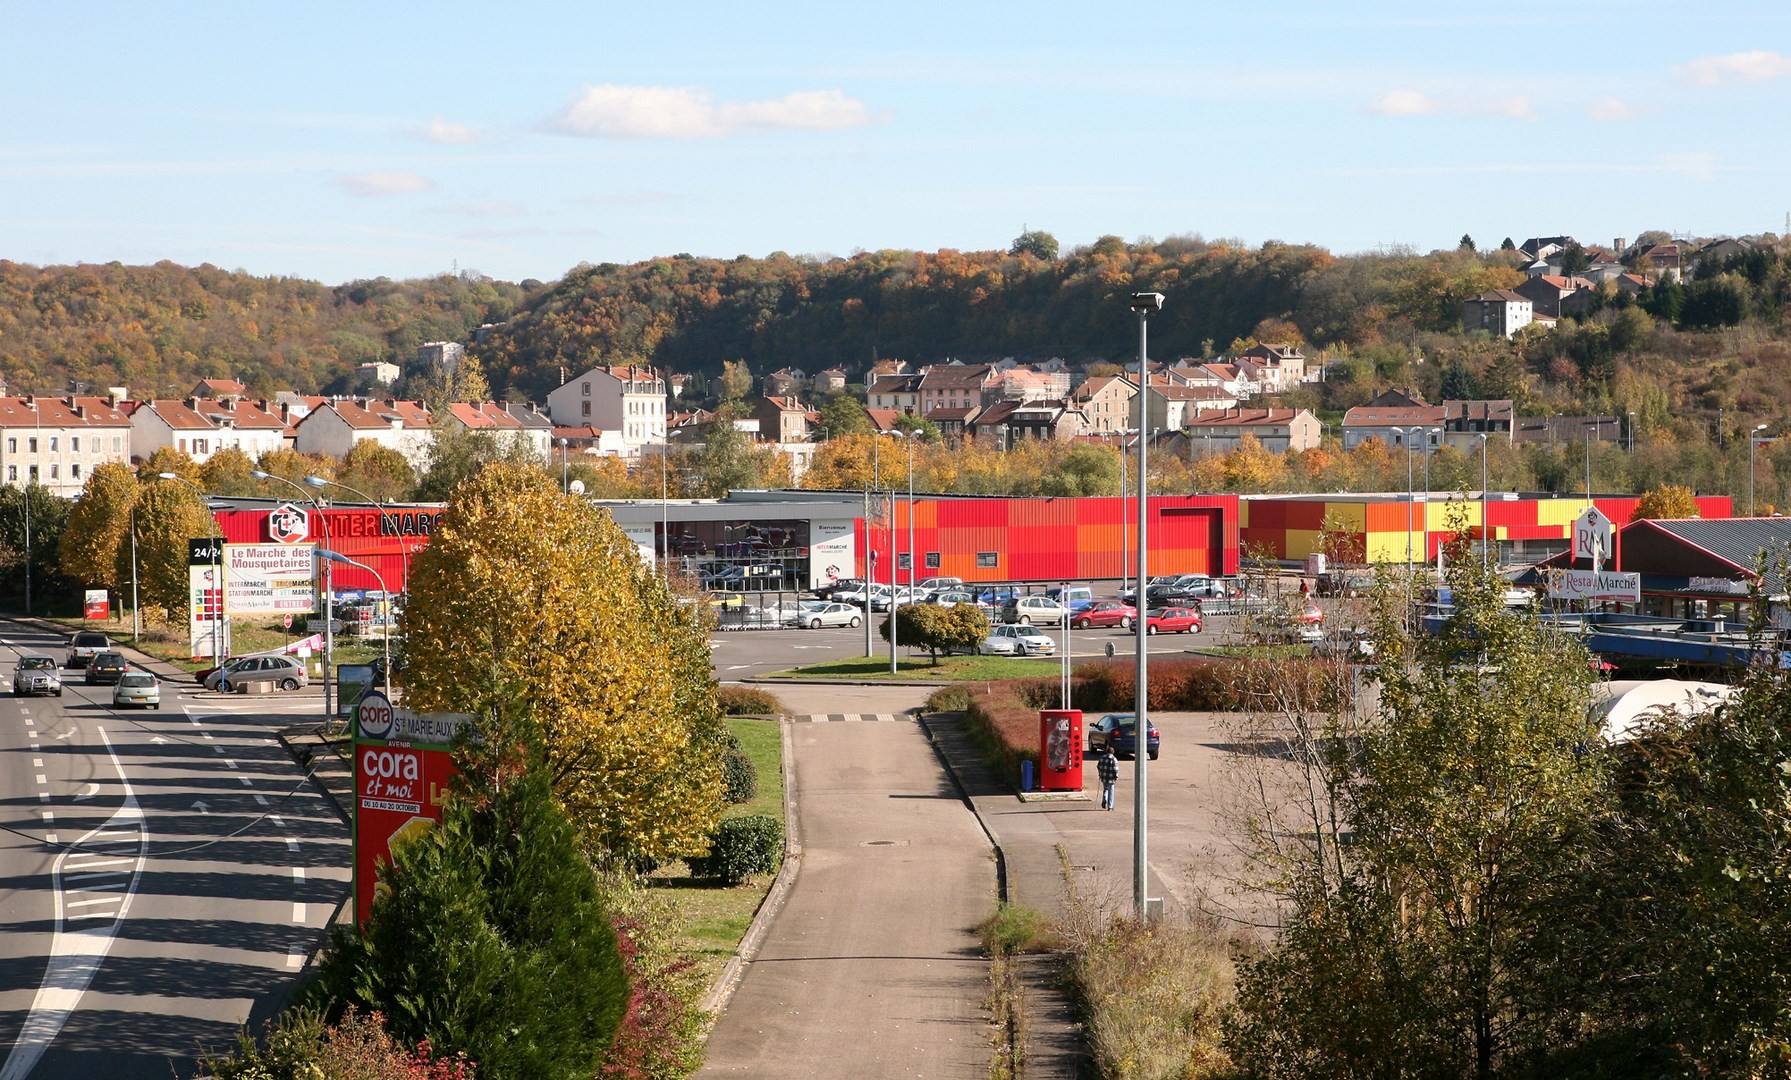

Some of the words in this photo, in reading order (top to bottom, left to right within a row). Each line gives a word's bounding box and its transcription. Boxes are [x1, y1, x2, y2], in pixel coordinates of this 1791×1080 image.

[232, 549, 244, 558] Le
[246, 548, 286, 558] Marché
[292, 547, 311, 558] des
[232, 559, 311, 569] Mousquetaires
[360, 706, 391, 724] cora
[408, 719, 434, 736] MARIE
[436, 722, 452, 737] AUX
[388, 740, 411, 748] AVENIR
[363, 750, 418, 780] cora
[366, 776, 383, 795] et
[385, 780, 413, 798] moi
[363, 800, 371, 808] DU
[396, 804, 418, 812] OCTOBRE
